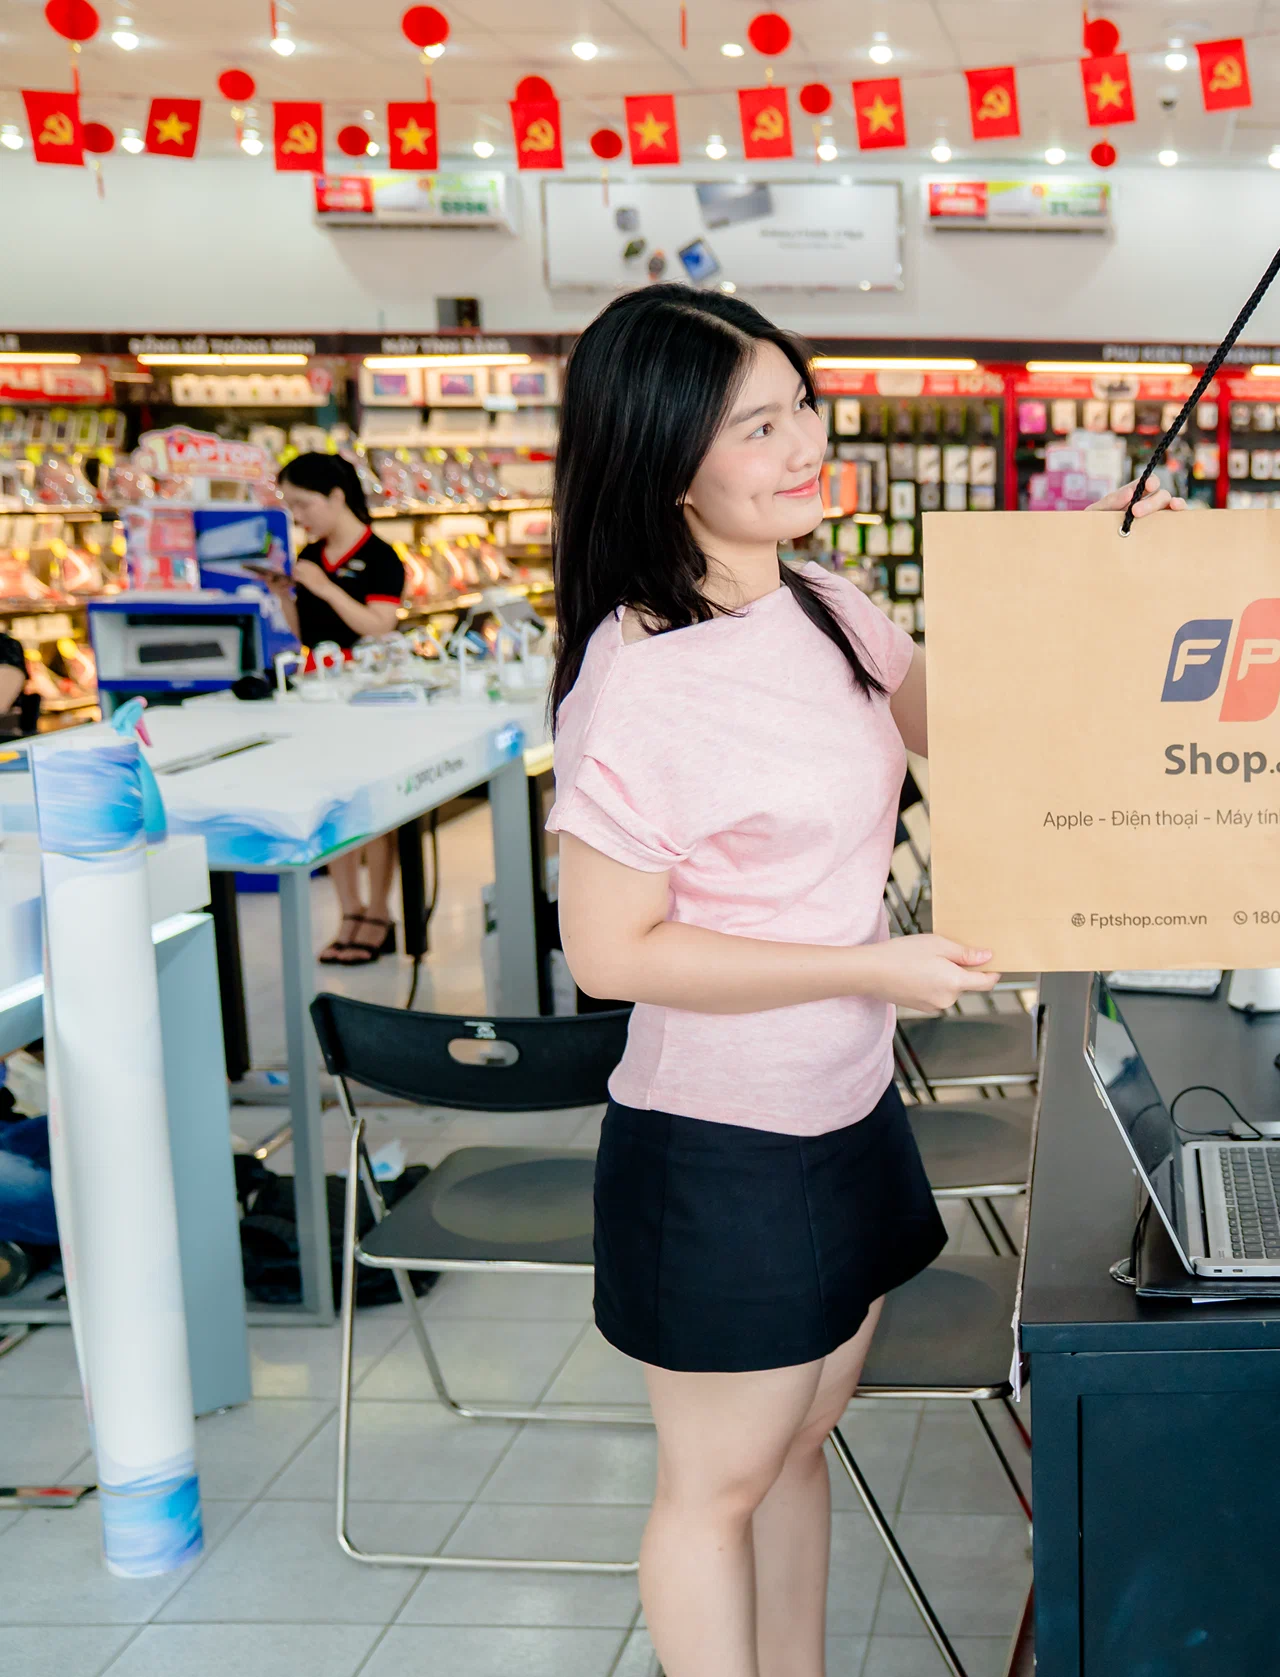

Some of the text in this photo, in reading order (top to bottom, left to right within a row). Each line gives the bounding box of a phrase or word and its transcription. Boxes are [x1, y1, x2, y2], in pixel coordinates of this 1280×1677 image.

[1043, 811, 1094, 830] Apple
[1111, 810, 1151, 830] Điện
[1155, 809, 1198, 830] thoại
[1216, 809, 1253, 828] Máy
[1089, 912, 1208, 930] Fptshop.com.vn
